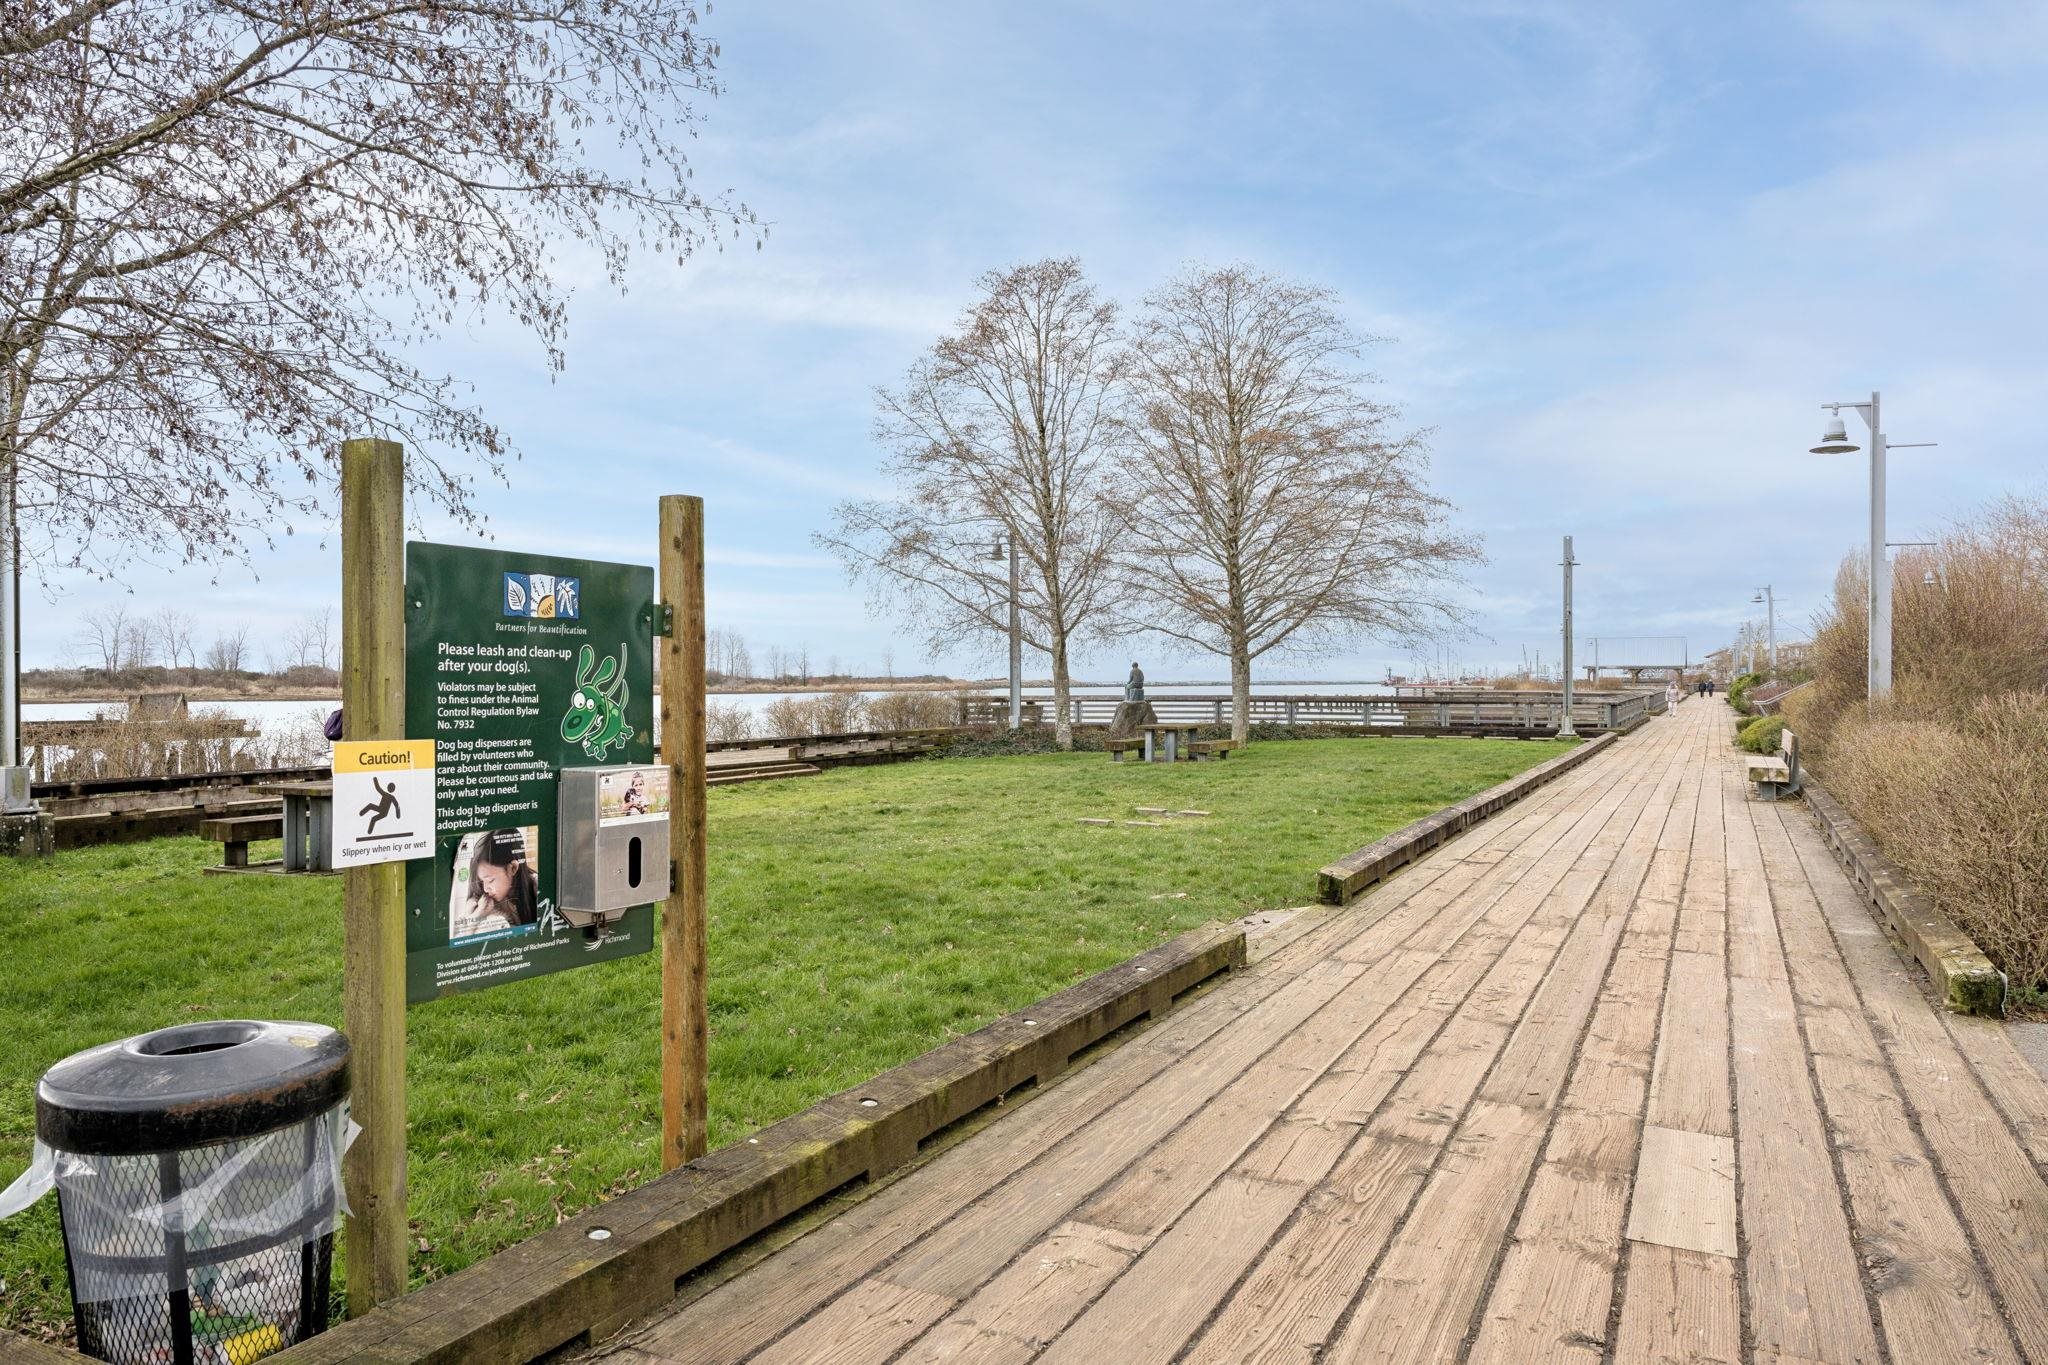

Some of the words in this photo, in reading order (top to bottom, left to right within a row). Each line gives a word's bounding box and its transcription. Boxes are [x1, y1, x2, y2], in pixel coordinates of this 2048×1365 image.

[438, 642, 474, 655] Please
[477, 644, 505, 657] leash
[507, 646, 527, 657] and
[529, 646, 572, 661] clean-up
[438, 659, 466, 672] after
[467, 662, 492, 674] your
[494, 660, 531, 675] dog(s).
[437, 682, 476, 692] Violators
[477, 684, 495, 693] may
[495, 683, 506, 692] be
[508, 682, 536, 694] subject
[437, 695, 447, 704] to
[448, 694, 468, 704] fines
[470, 694, 496, 704] under
[496, 694, 510, 704] the
[511, 694, 539, 704] Animal
[437, 707, 469, 717] Control
[471, 707, 515, 718] Regulation
[516, 707, 539, 717] Bylaw
[437, 720, 453, 730] No.
[454, 720, 475, 729] 7932
[437, 740, 456, 751] Dog
[457, 740, 474, 751] bag
[475, 738, 518, 750] dispensers
[359, 751, 411, 766] Caution!
[437, 752, 459, 762] filled
[460, 751, 472, 763] by
[473, 750, 515, 760] volunteers
[516, 749, 534, 758] who
[436, 766, 455, 774] care
[457, 764, 482, 774] about
[484, 762, 502, 772] their
[504, 760, 550, 770] community.
[437, 777, 465, 787] Please
[466, 776, 477, 785] be
[478, 773, 519, 784] courteous
[520, 771, 535, 781] and
[536, 771, 553, 779] take
[436, 789, 456, 800] only
[457, 787, 479, 797] what
[480, 788, 496, 798] you
[497, 784, 519, 794] need.
[436, 808, 454, 817] This
[456, 805, 473, 816] dog
[474, 804, 490, 815] bag
[492, 801, 530, 813] dispenser
[531, 800, 538, 809] is
[436, 818, 473, 830] adopted
[474, 817, 488, 827] by:
[342, 845, 371, 857] Slippery
[371, 844, 391, 853] when
[392, 842, 402, 851] icy
[413, 840, 427, 849] wet
